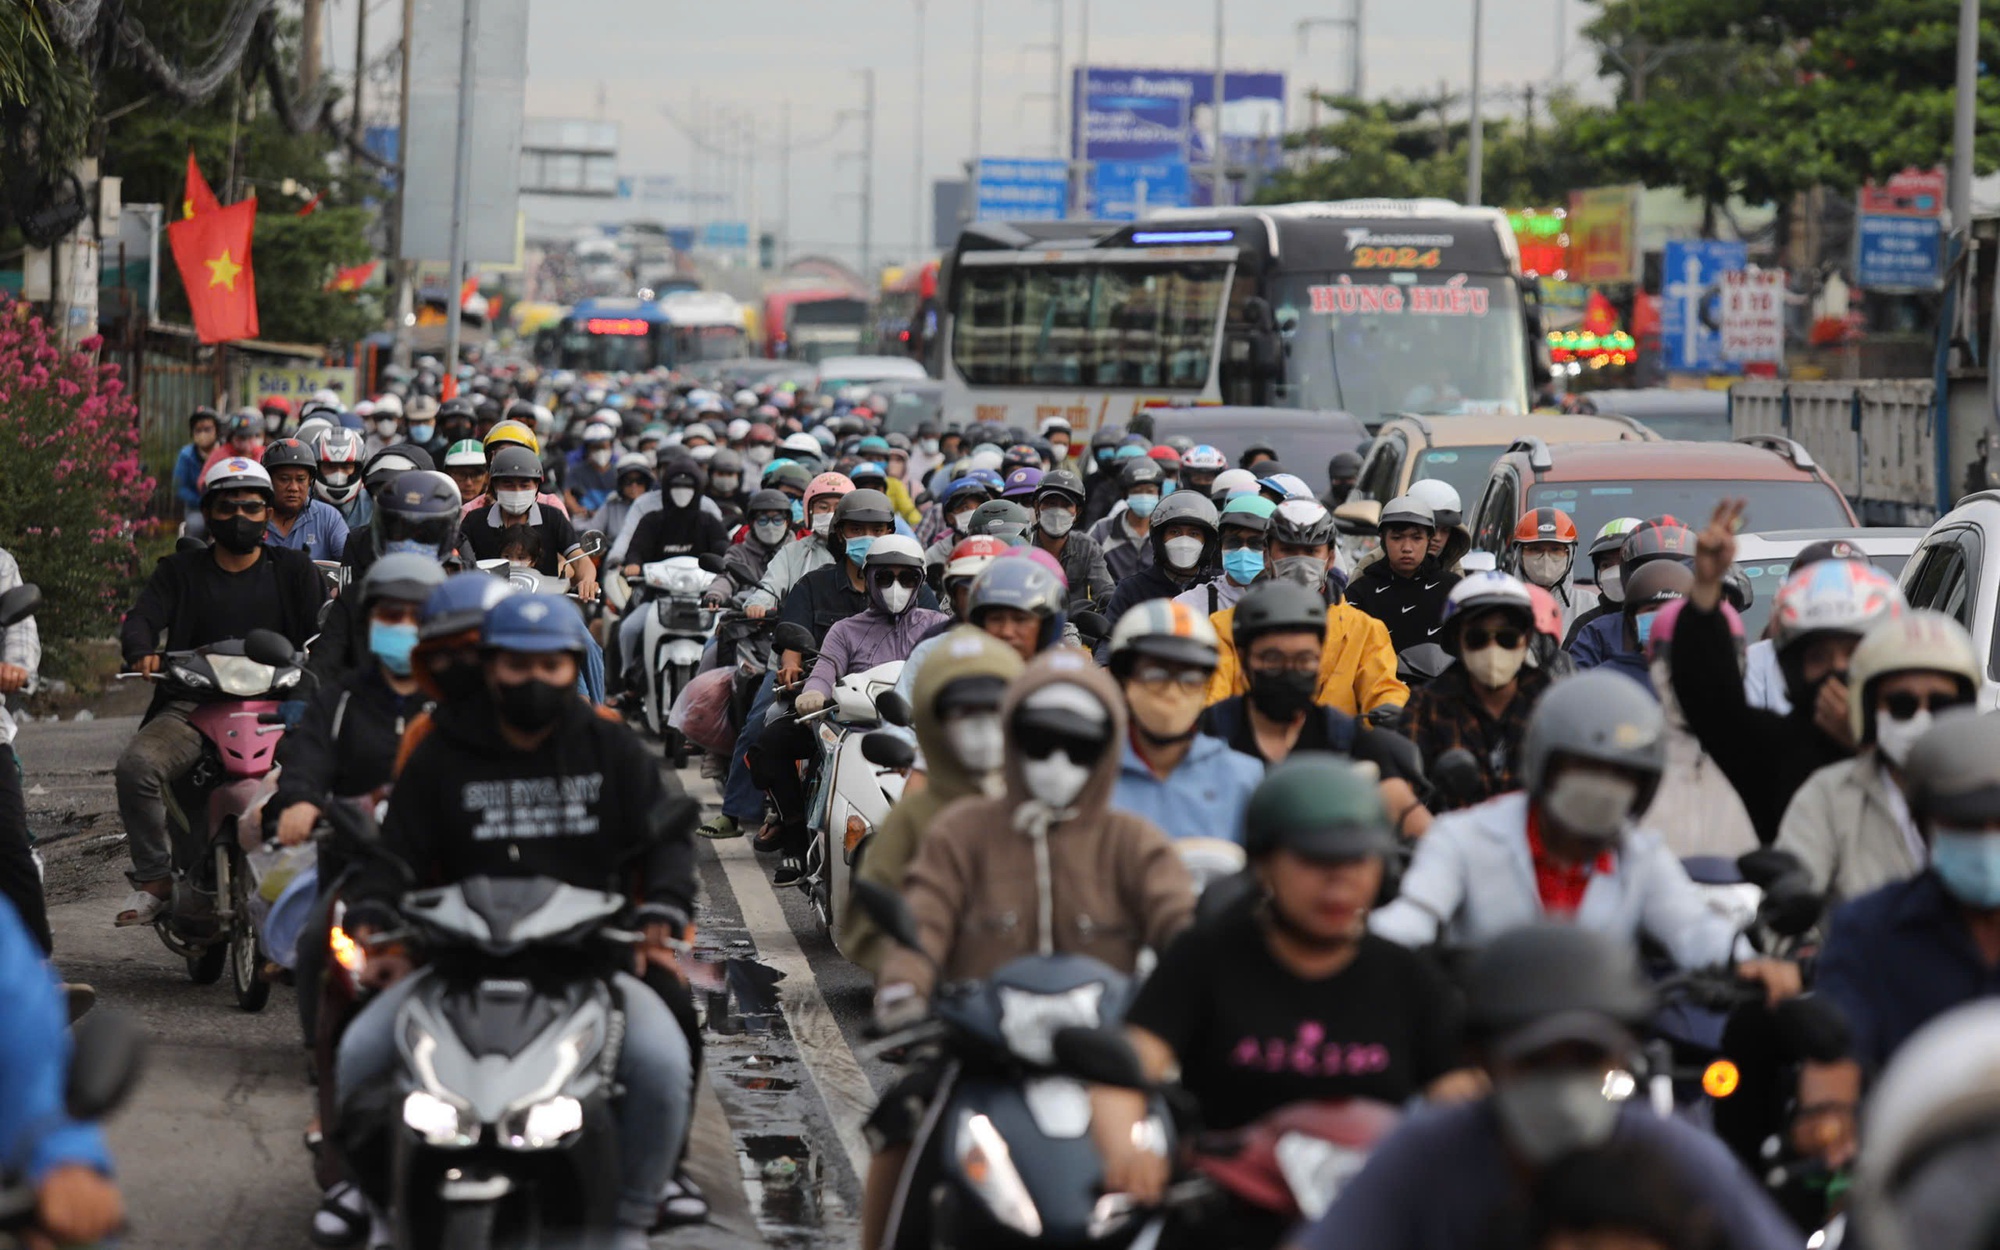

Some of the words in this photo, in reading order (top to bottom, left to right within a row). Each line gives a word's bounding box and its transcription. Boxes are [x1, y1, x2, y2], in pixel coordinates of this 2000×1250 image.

[1353, 247, 1441, 268] 2024
[1307, 273, 1404, 314] HÙNG
[1408, 272, 1489, 315] HIẾU
[1652, 591, 1683, 599] Andes
